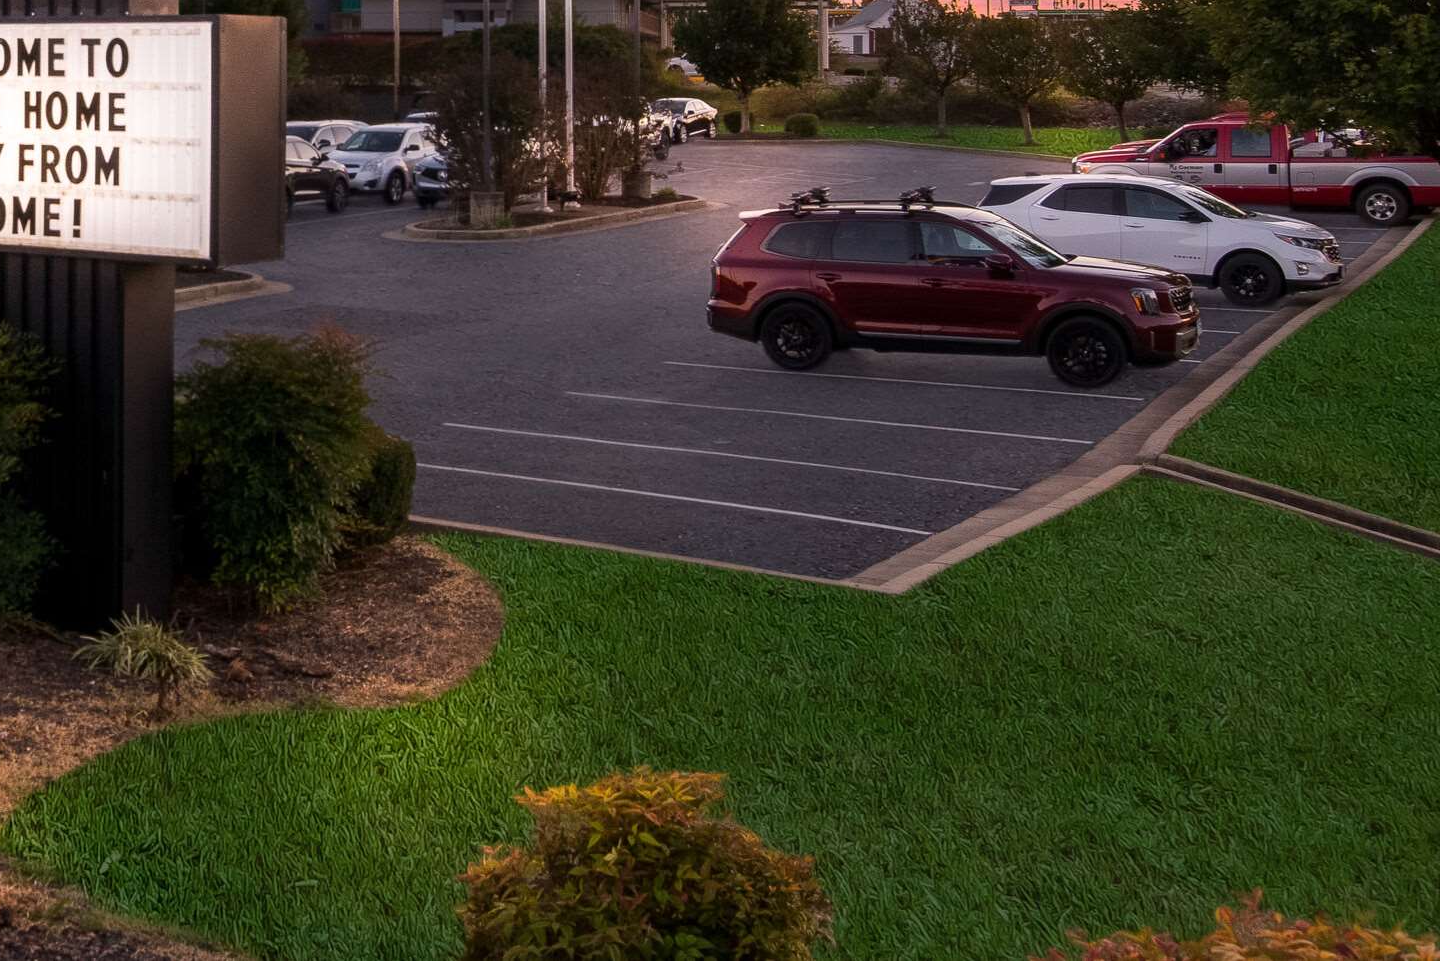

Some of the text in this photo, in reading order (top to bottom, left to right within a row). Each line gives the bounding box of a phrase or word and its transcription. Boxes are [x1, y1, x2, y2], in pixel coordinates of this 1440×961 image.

[80, 37, 129, 78] TO
[24, 91, 127, 132] HOME
[18, 143, 120, 187] FROM
